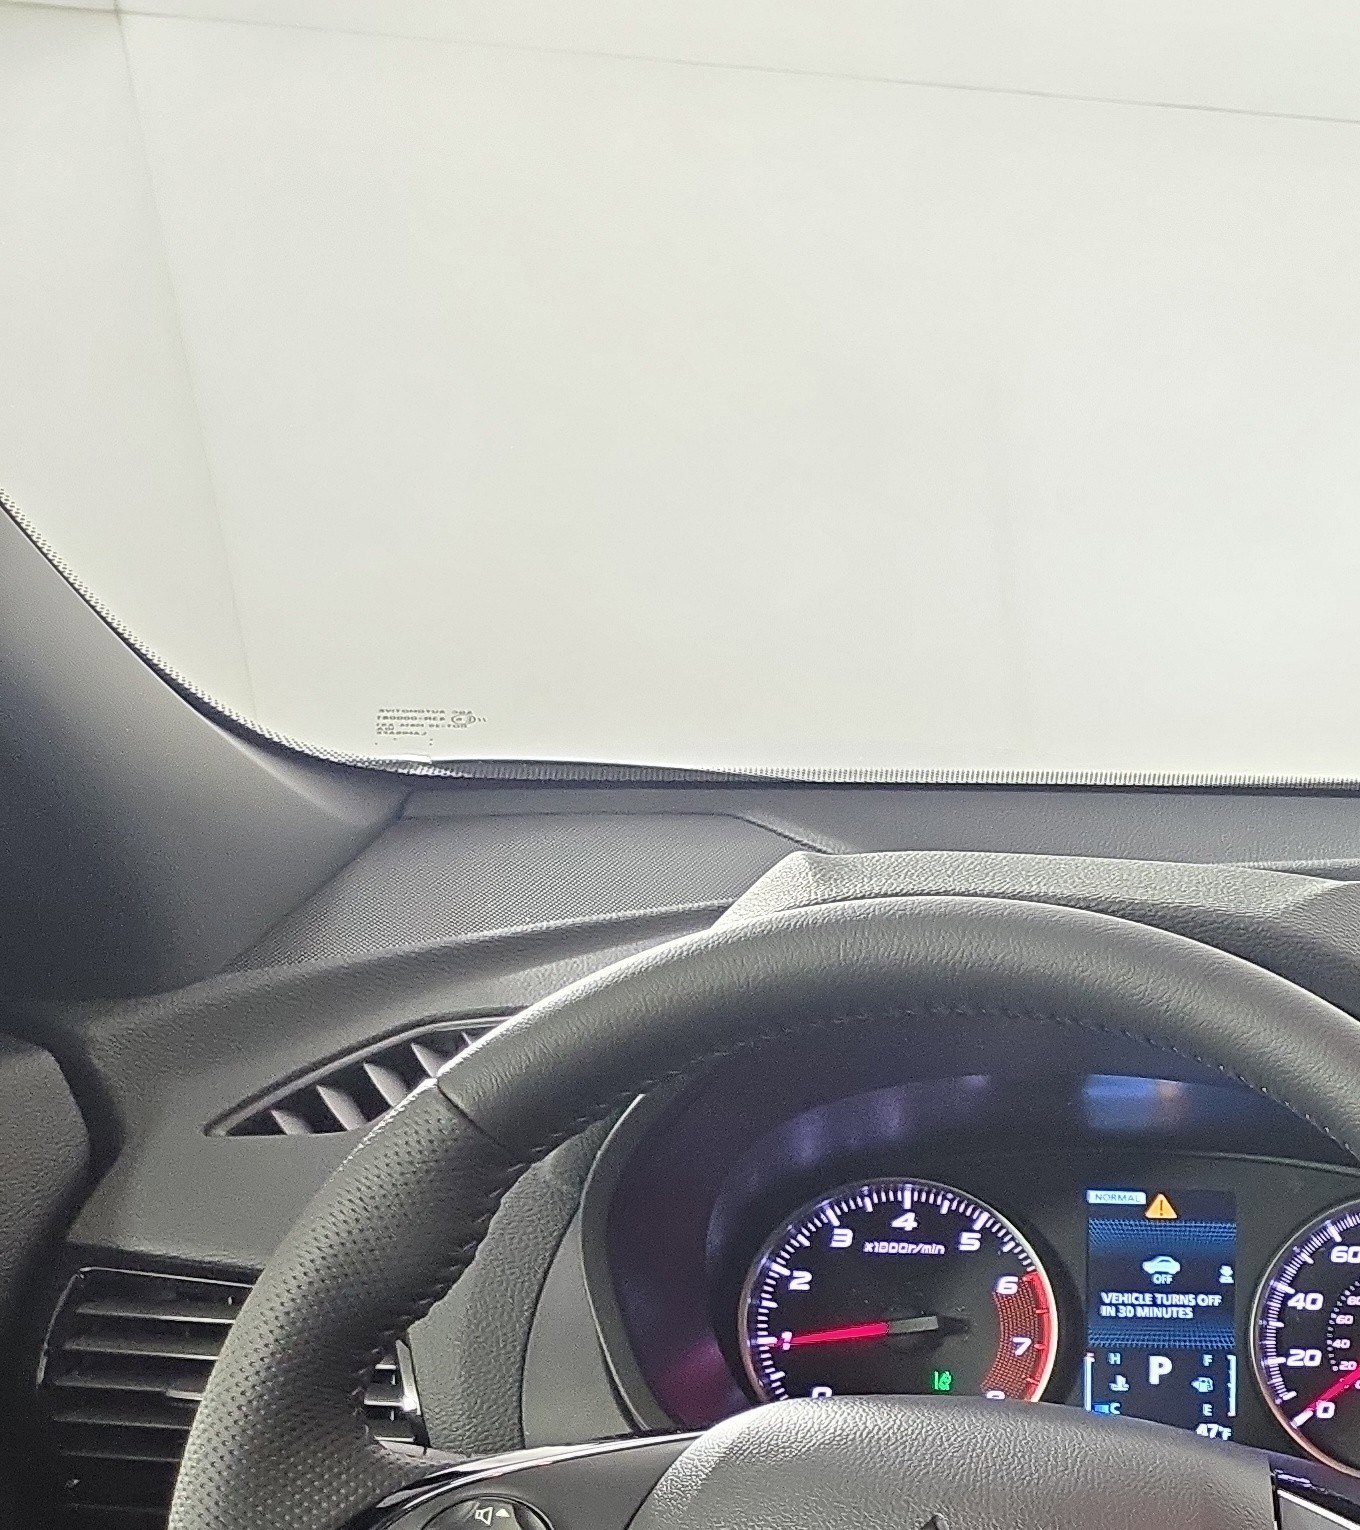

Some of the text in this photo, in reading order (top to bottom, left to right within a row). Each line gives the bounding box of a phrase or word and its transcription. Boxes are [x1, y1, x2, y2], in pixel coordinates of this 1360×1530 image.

[1094, 1193, 1140, 1202] NORMAL
[891, 1212, 918, 1230] 4
[830, 1229, 853, 1248] 3
[958, 1232, 982, 1250] 5
[788, 1271, 812, 1290] 2
[996, 1276, 1018, 1294] 6
[1153, 1274, 1173, 1284] OFF
[1100, 1292, 1222, 1306] VEHICLE TURNS OFF
[1287, 1293, 1324, 1310] 40
[1100, 1305, 1193, 1319] IN 30 MINUTES
[1336, 1315, 1354, 1325] 60
[1012, 1338, 1032, 1355] 7
[1333, 1339, 1350, 1349] 40
[1287, 1349, 1322, 1366] 20
[1339, 1361, 1357, 1371] 20
[1149, 1355, 1172, 1384] P
[1316, 1401, 1335, 1418] 0
